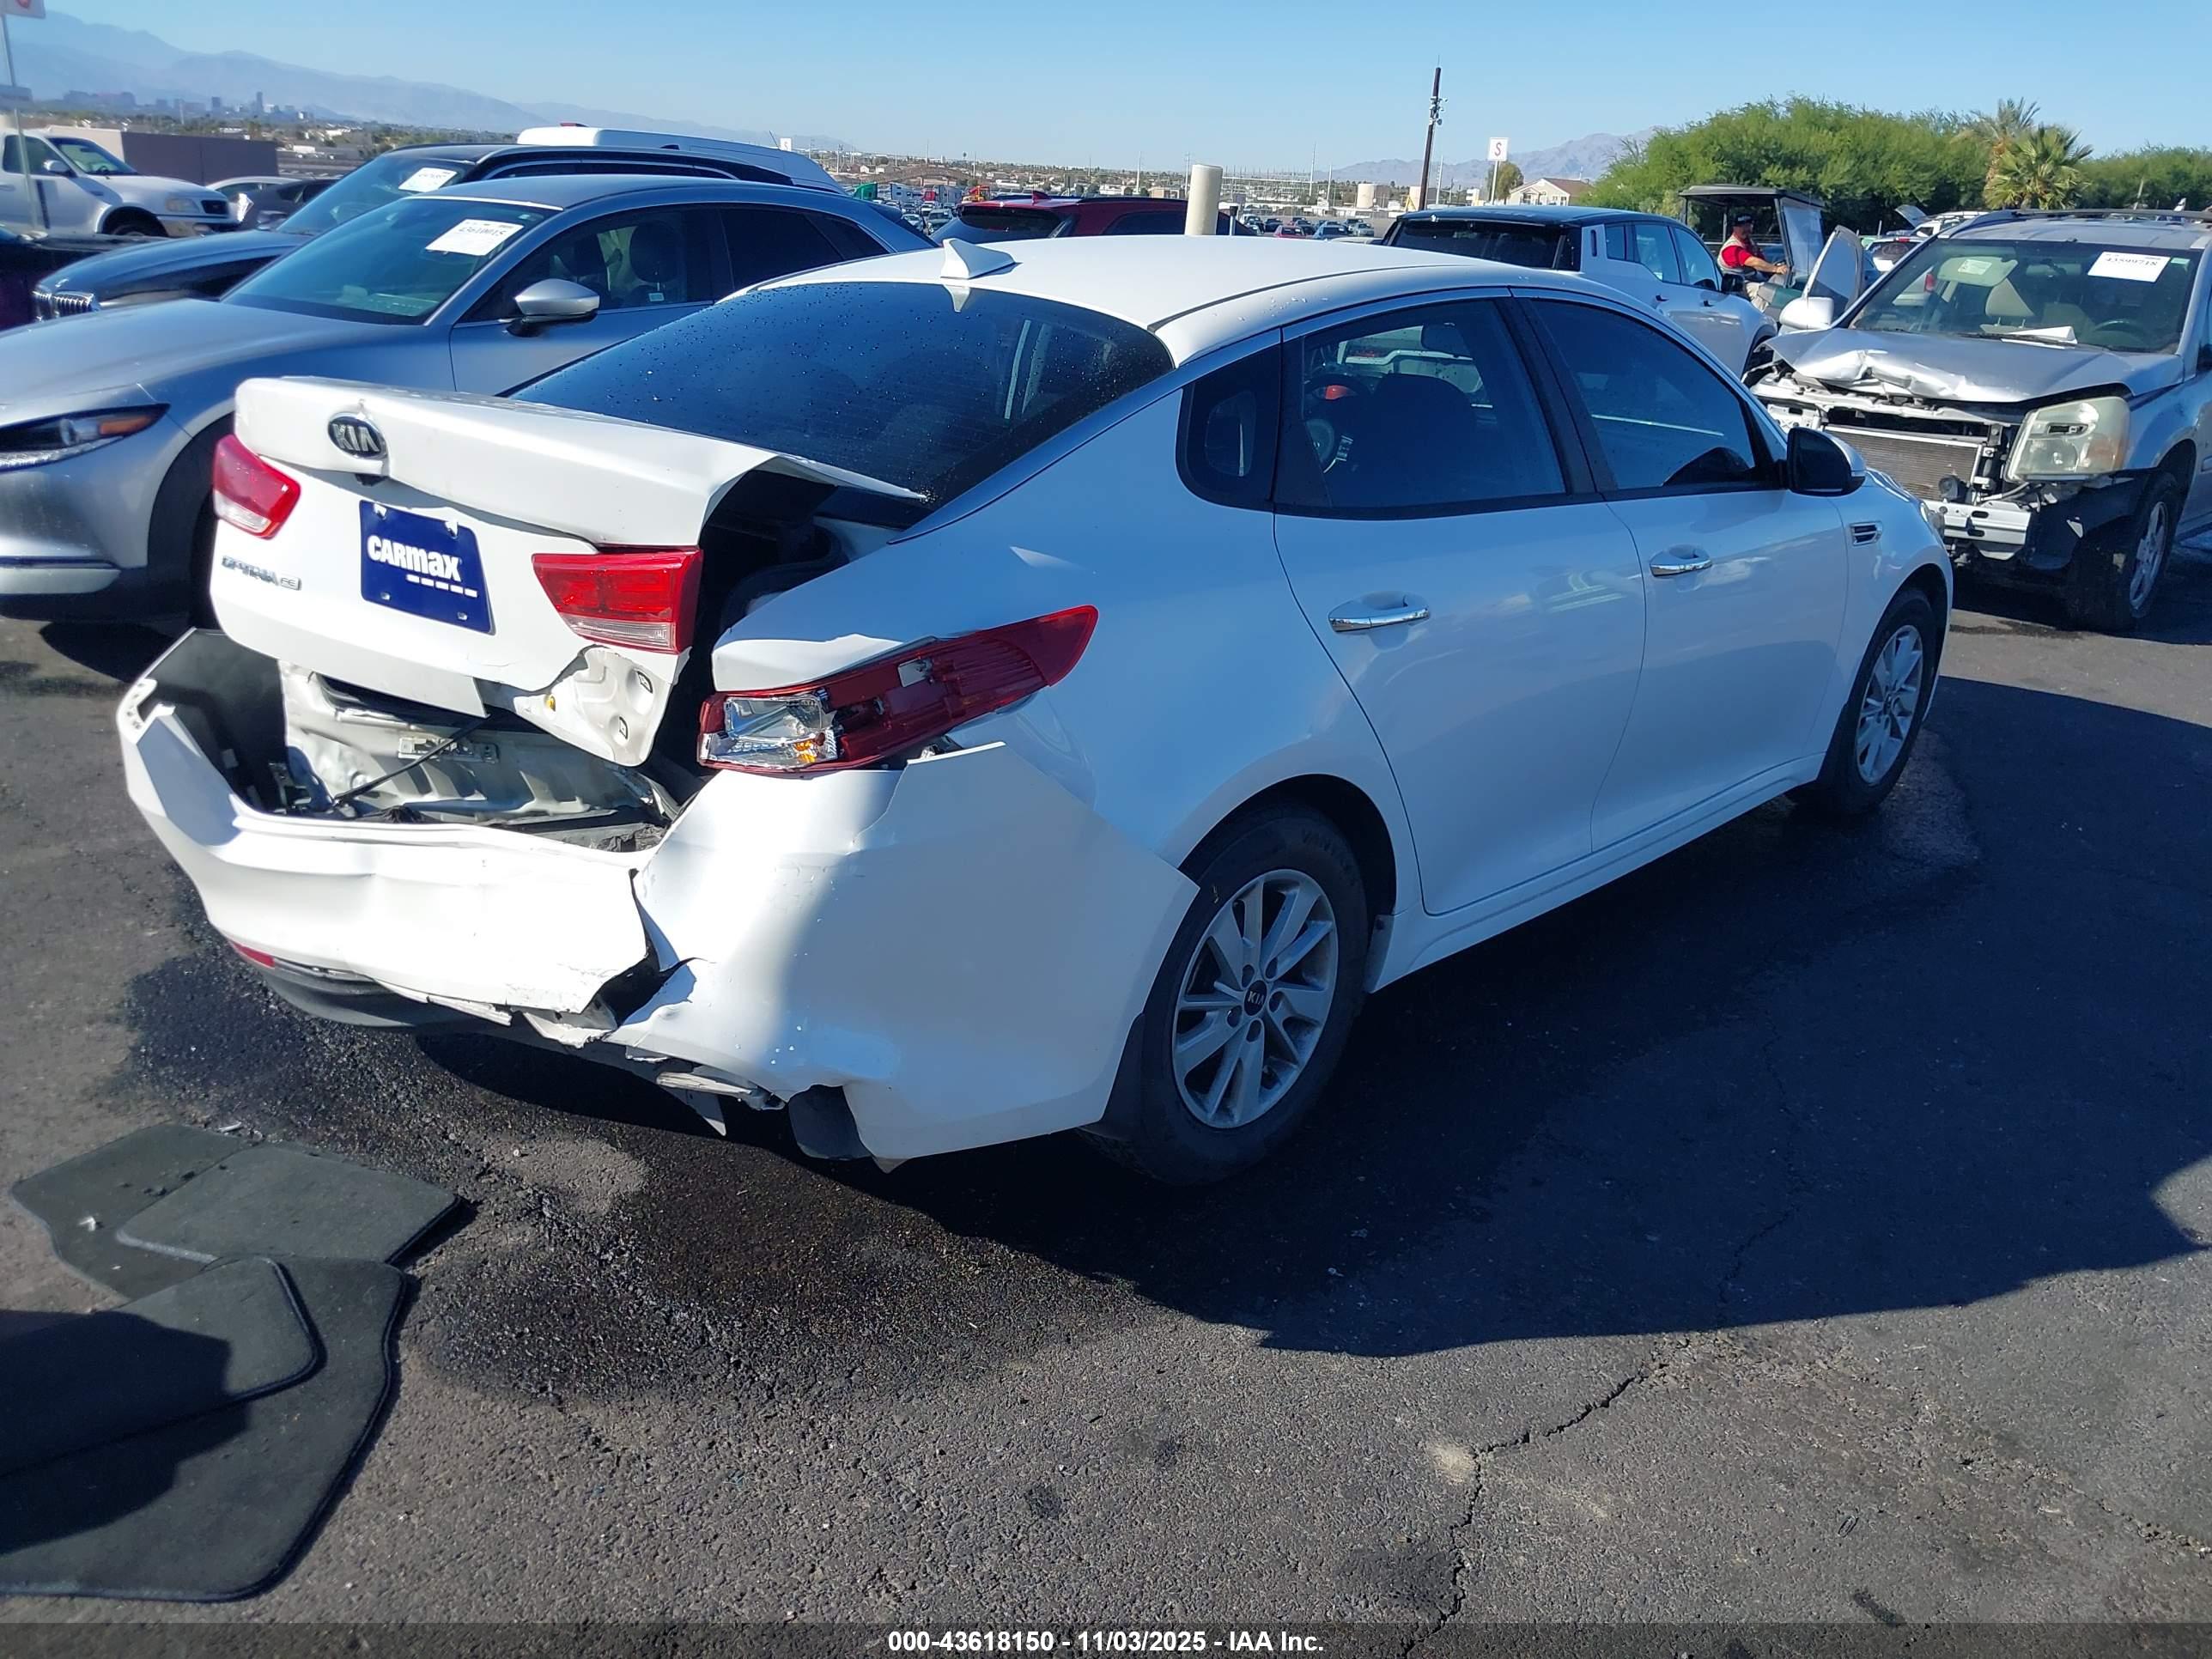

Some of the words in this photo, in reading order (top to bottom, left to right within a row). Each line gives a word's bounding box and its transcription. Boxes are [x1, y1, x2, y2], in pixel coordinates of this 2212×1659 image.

[1494, 142, 1502, 156] S
[331, 423, 380, 452] KIA
[1248, 990, 1265, 1005] KIA
